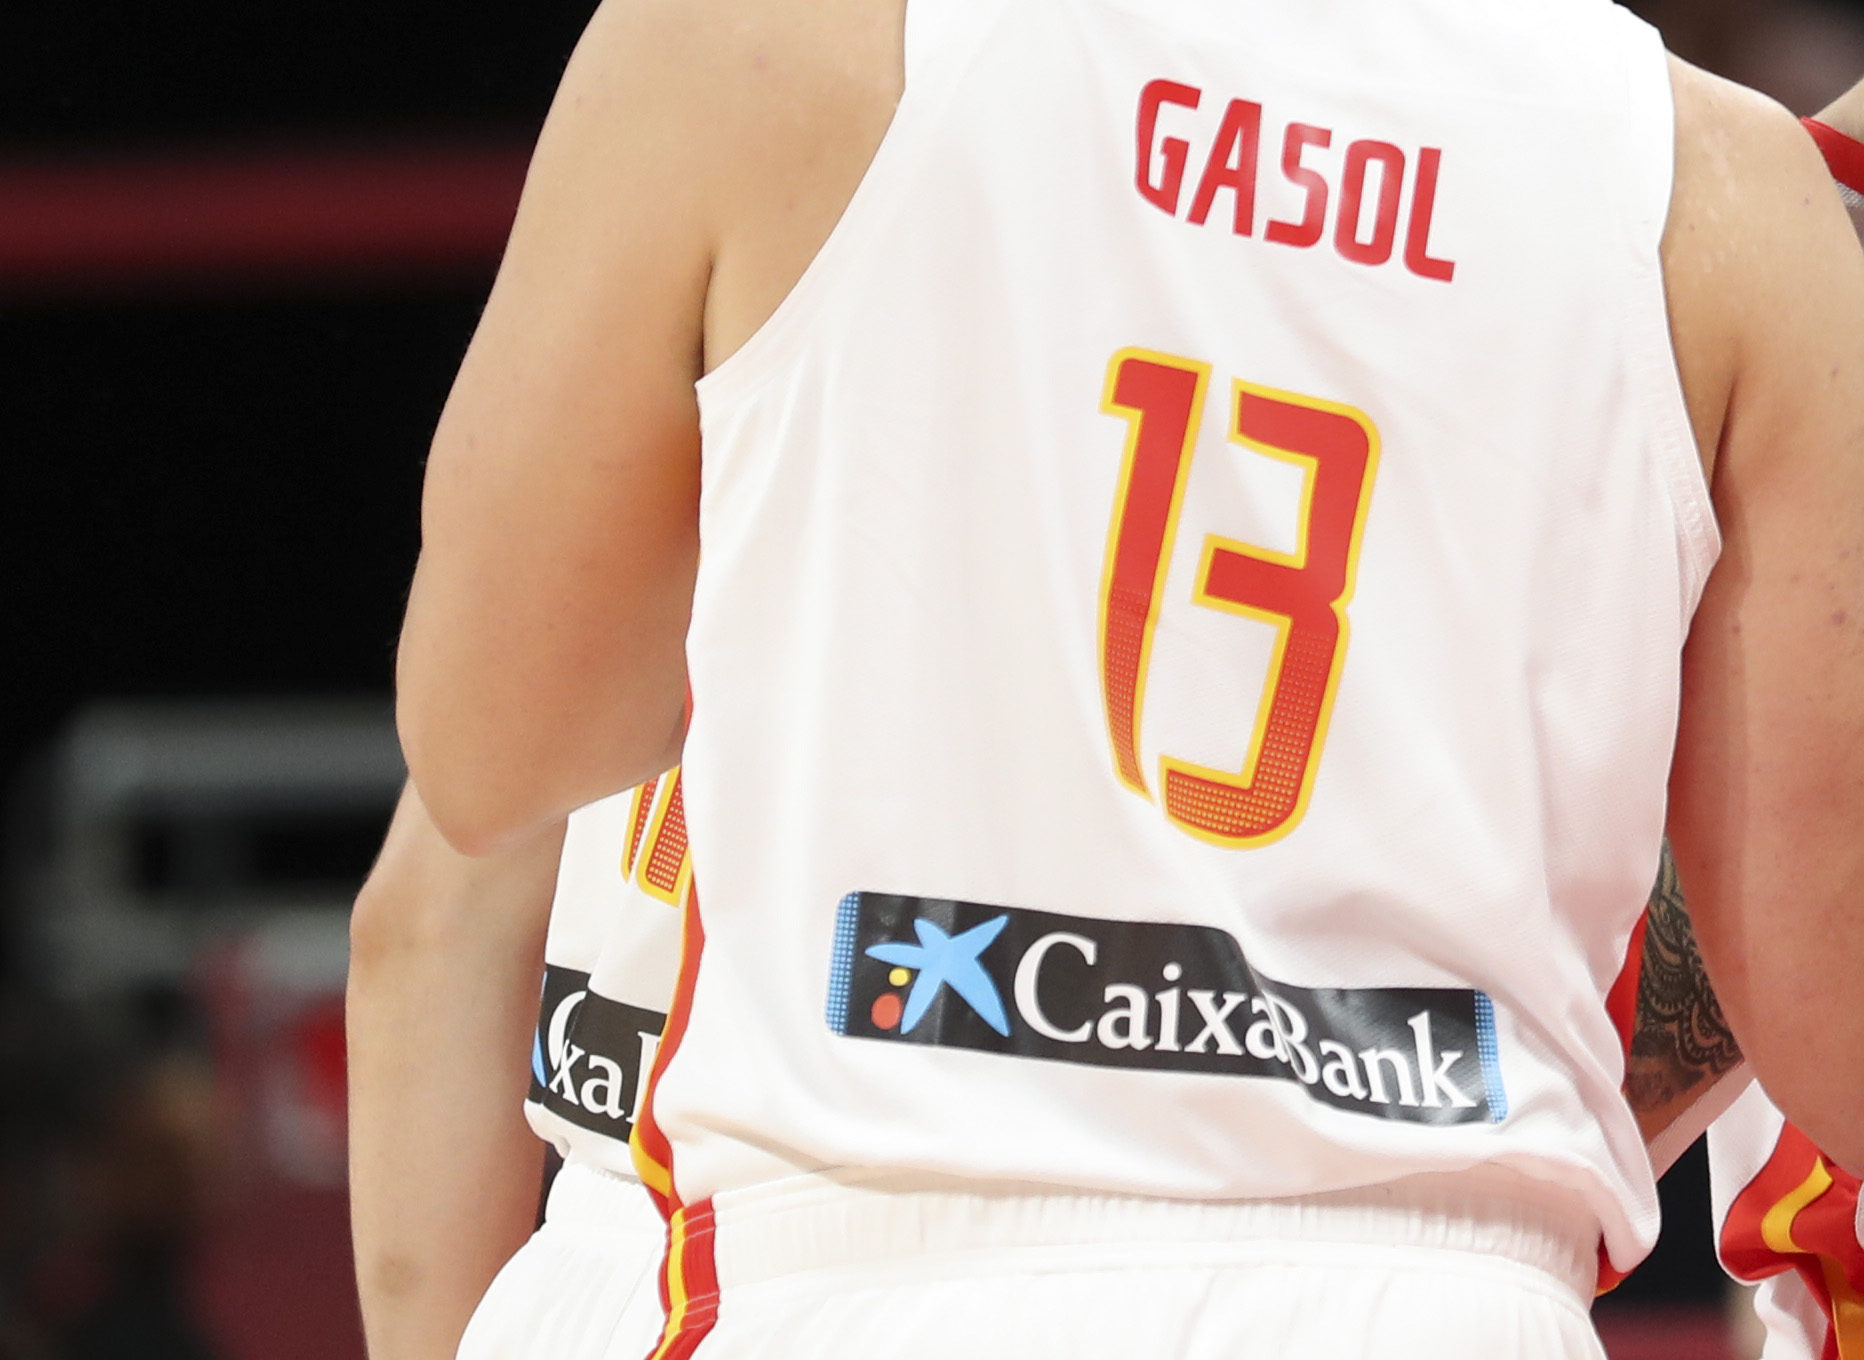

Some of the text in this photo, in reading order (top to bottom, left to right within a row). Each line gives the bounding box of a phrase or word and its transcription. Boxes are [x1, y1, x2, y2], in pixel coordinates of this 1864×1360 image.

[1134, 78, 1456, 282] GASOL
[1096, 346, 1382, 851] 13
[1013, 931, 1477, 1109] CaixaBank
